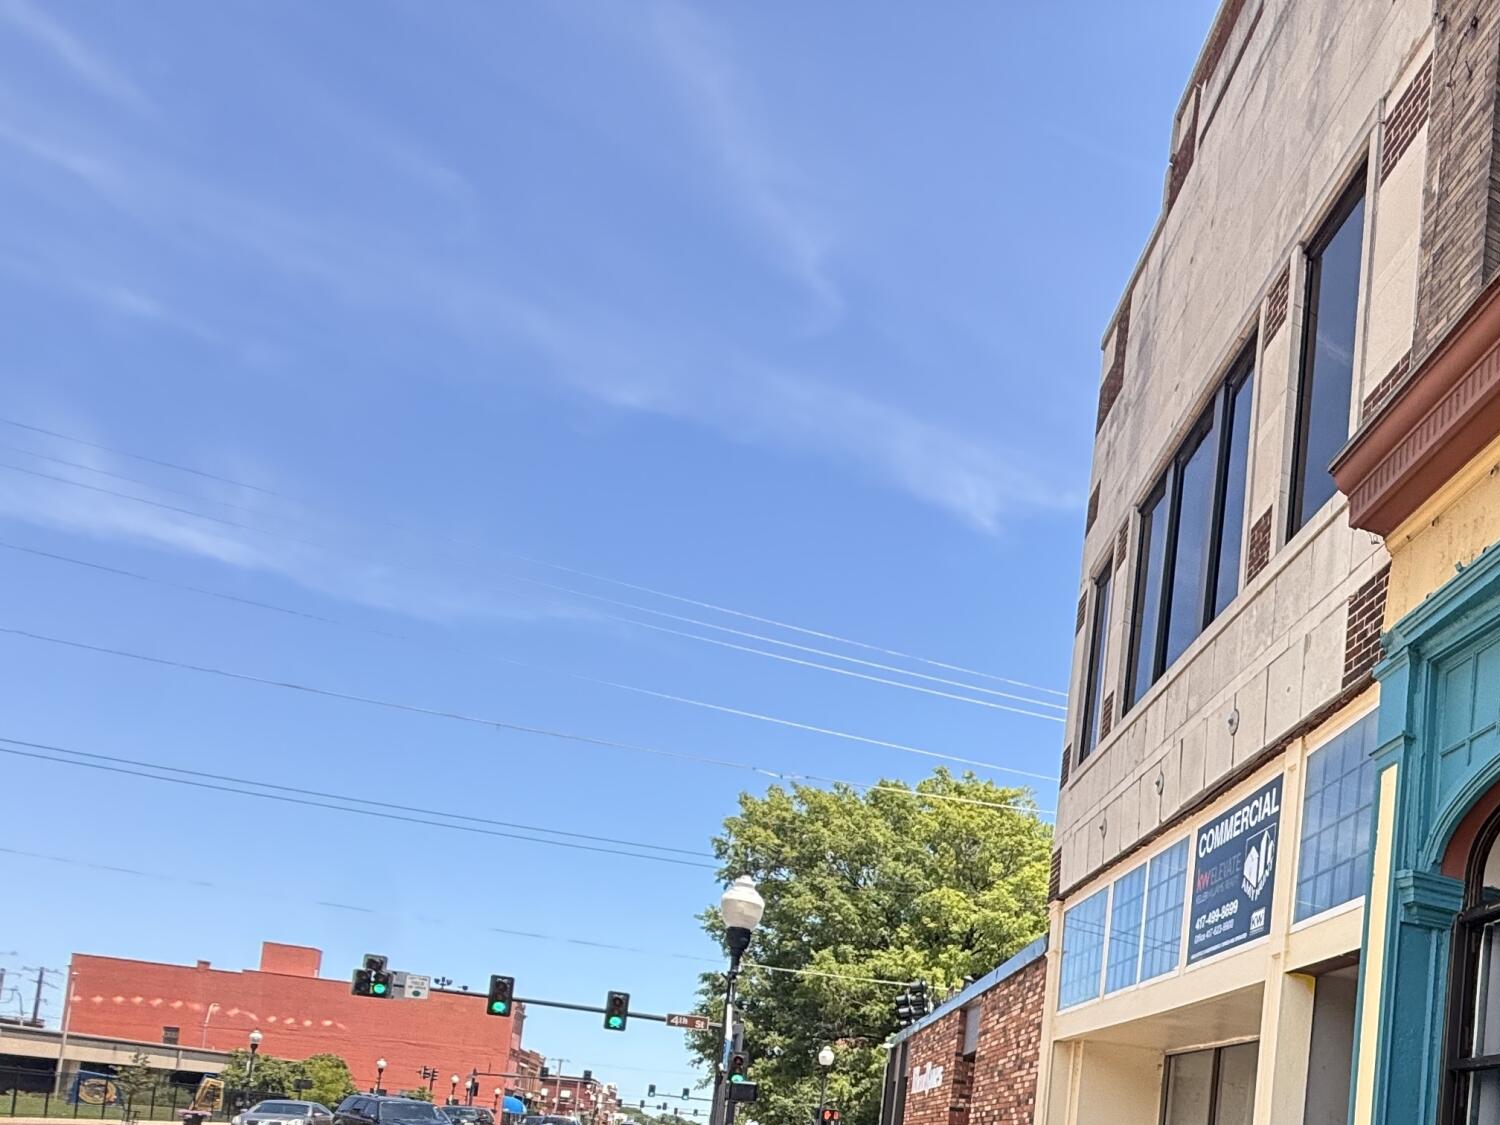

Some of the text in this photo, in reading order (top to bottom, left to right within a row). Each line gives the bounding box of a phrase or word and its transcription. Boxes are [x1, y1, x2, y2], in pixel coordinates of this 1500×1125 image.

[1199, 787, 1280, 858] COMMERCIAL
[670, 1015, 705, 1029] 4th St
